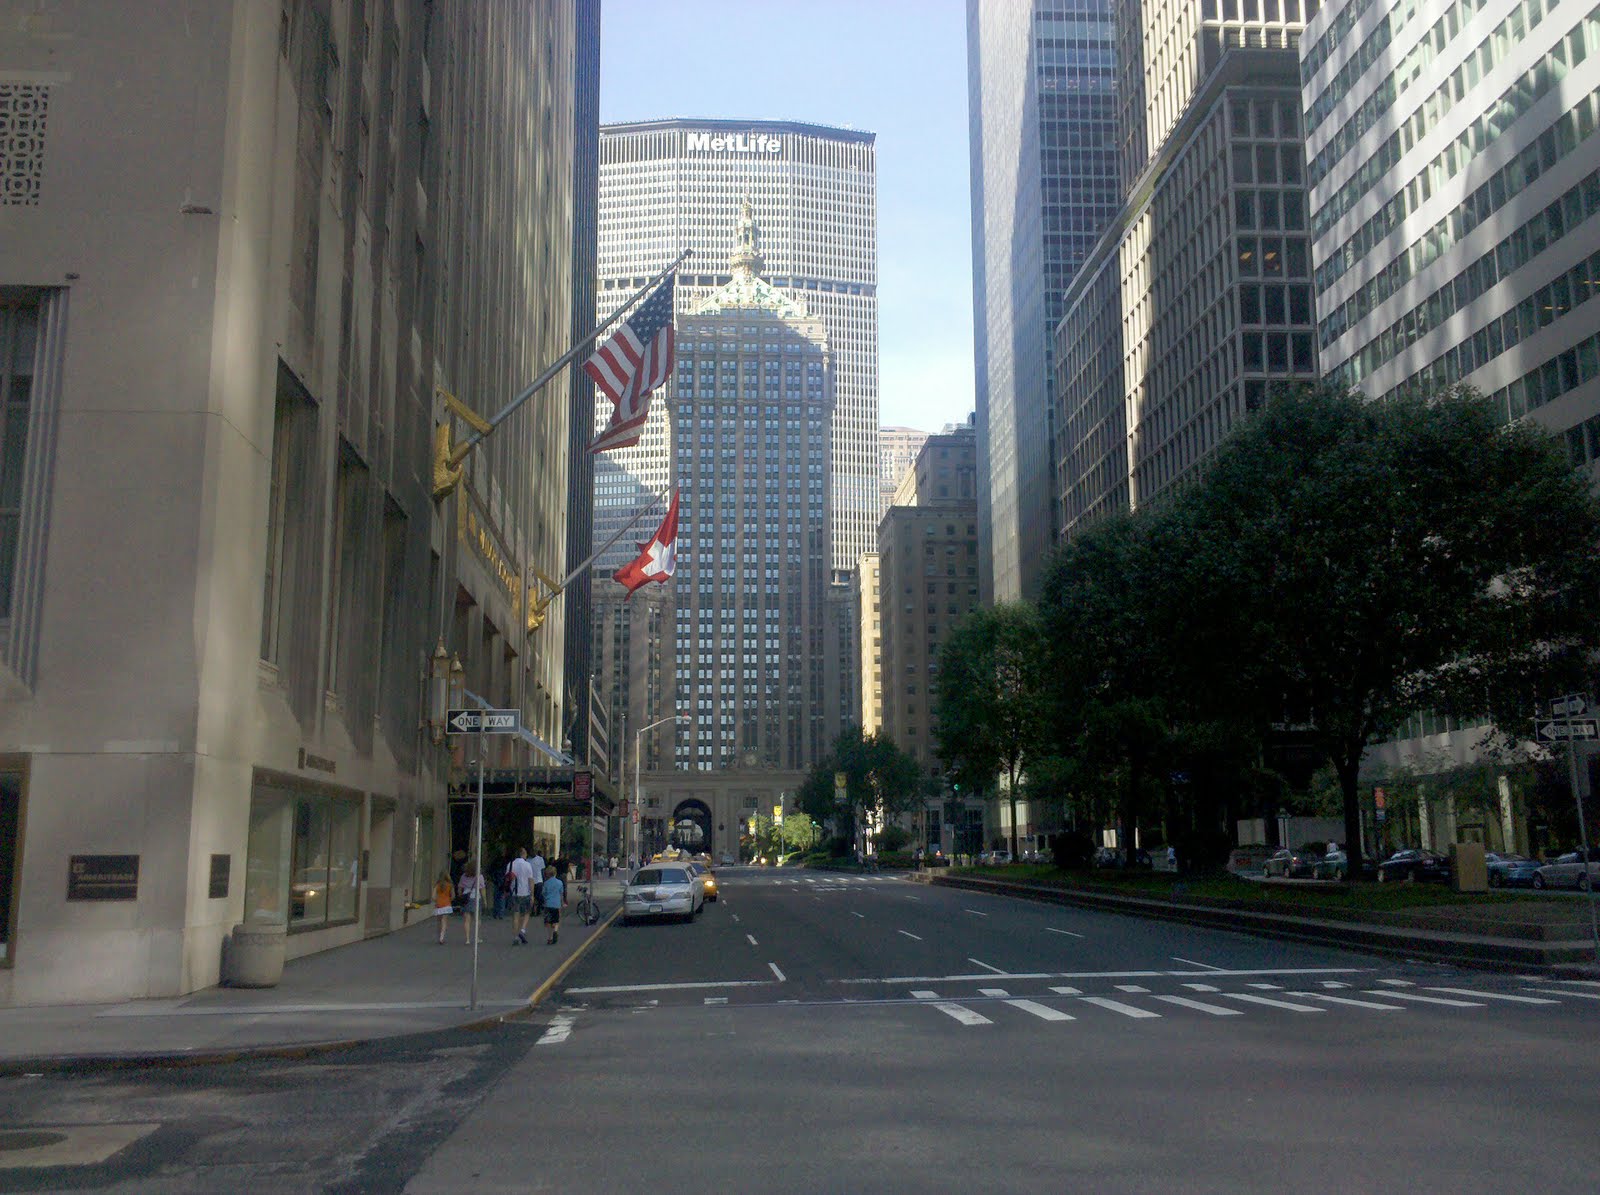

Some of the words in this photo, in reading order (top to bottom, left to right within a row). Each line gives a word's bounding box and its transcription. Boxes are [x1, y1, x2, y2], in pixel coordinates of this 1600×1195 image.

[686, 133, 781, 153] MetLife
[458, 716, 479, 726] ONE
[488, 716, 510, 726] WAY
[1546, 726, 1565, 736] ONE
[1573, 725, 1591, 735] WAY
